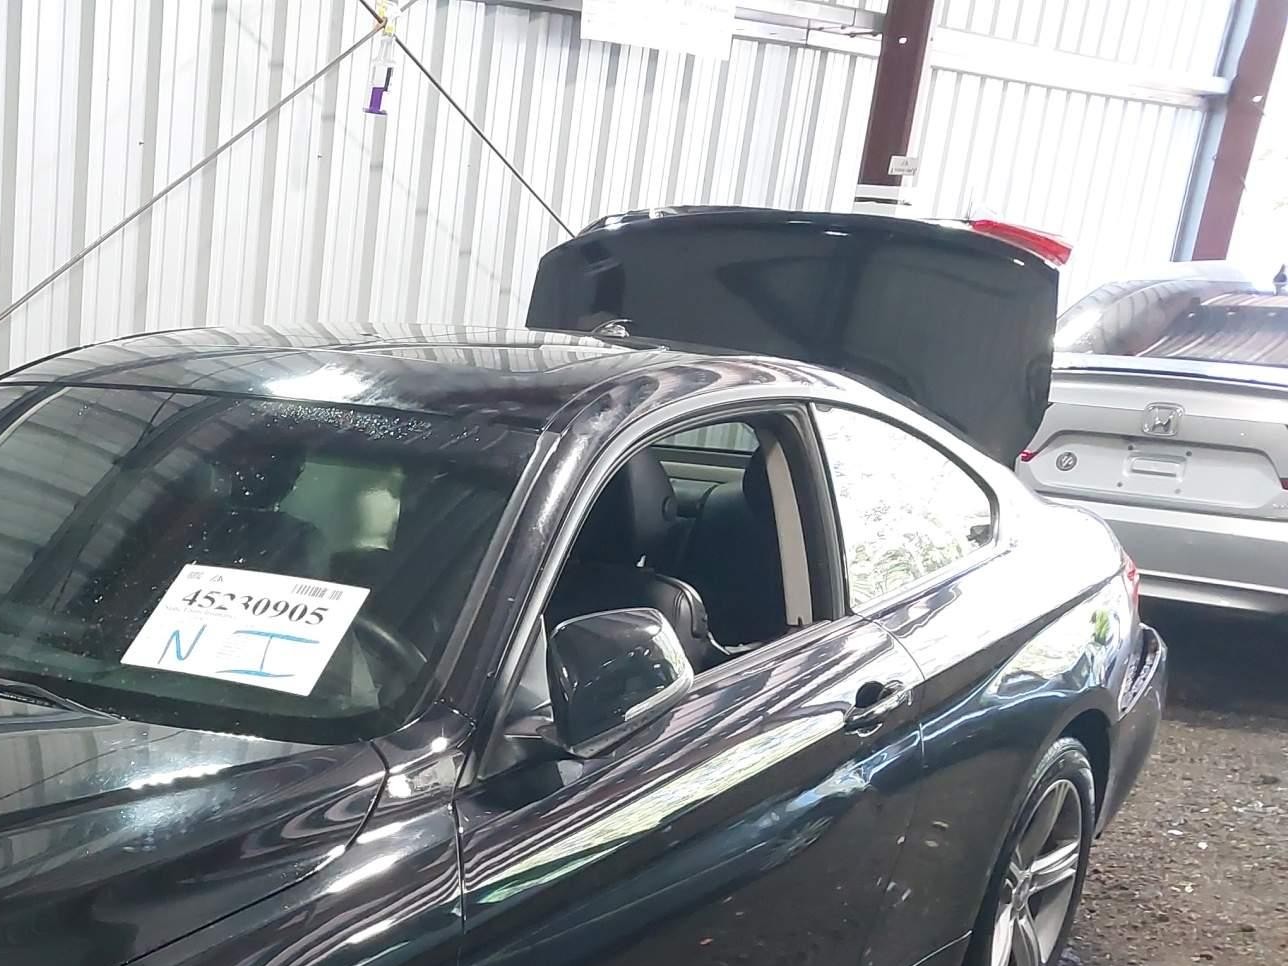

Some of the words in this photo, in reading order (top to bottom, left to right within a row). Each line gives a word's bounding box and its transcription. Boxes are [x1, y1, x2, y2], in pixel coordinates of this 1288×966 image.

[181, 588, 329, 626] 45230905
[158, 624, 207, 664] N
[215, 630, 320, 678] I
